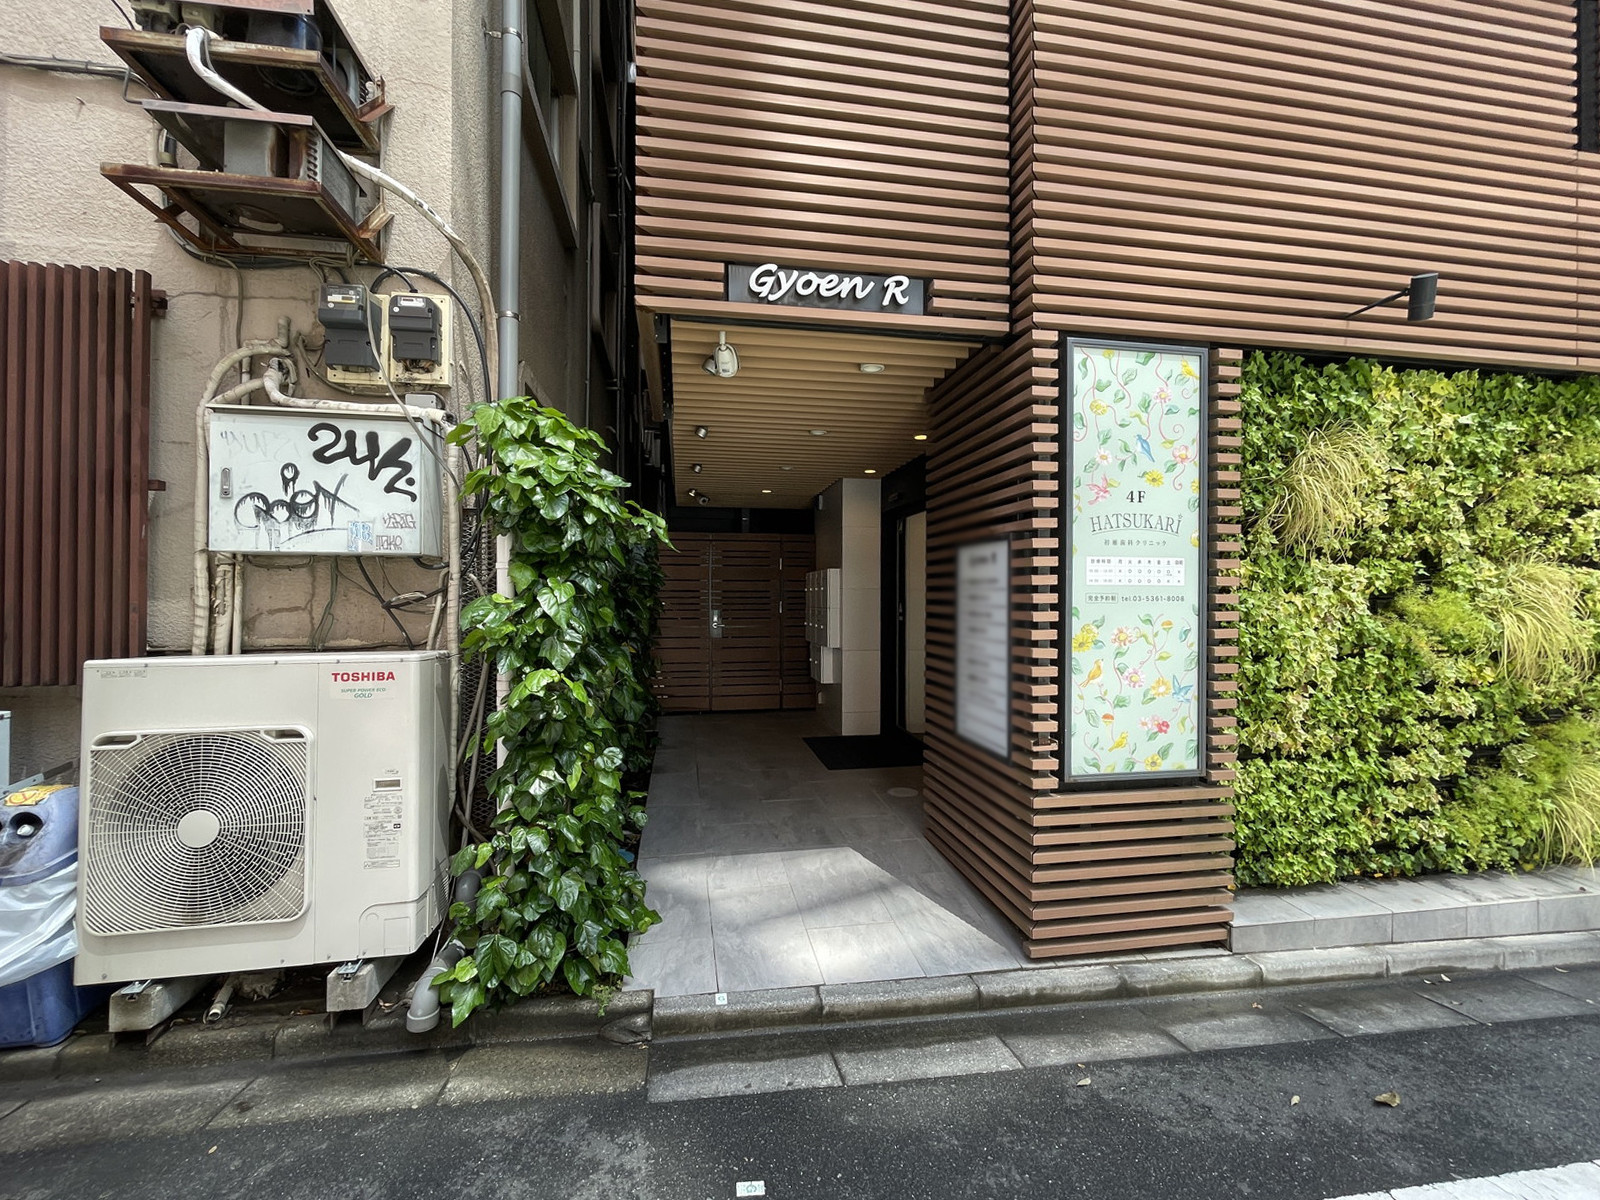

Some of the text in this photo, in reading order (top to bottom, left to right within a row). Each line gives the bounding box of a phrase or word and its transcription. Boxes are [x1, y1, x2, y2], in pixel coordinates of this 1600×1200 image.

[749, 263, 910, 306] Gyoen R
[1126, 490, 1146, 503] 4F
[1090, 513, 1183, 534] HATSUKARI
[331, 671, 395, 682] TOSHIBA
